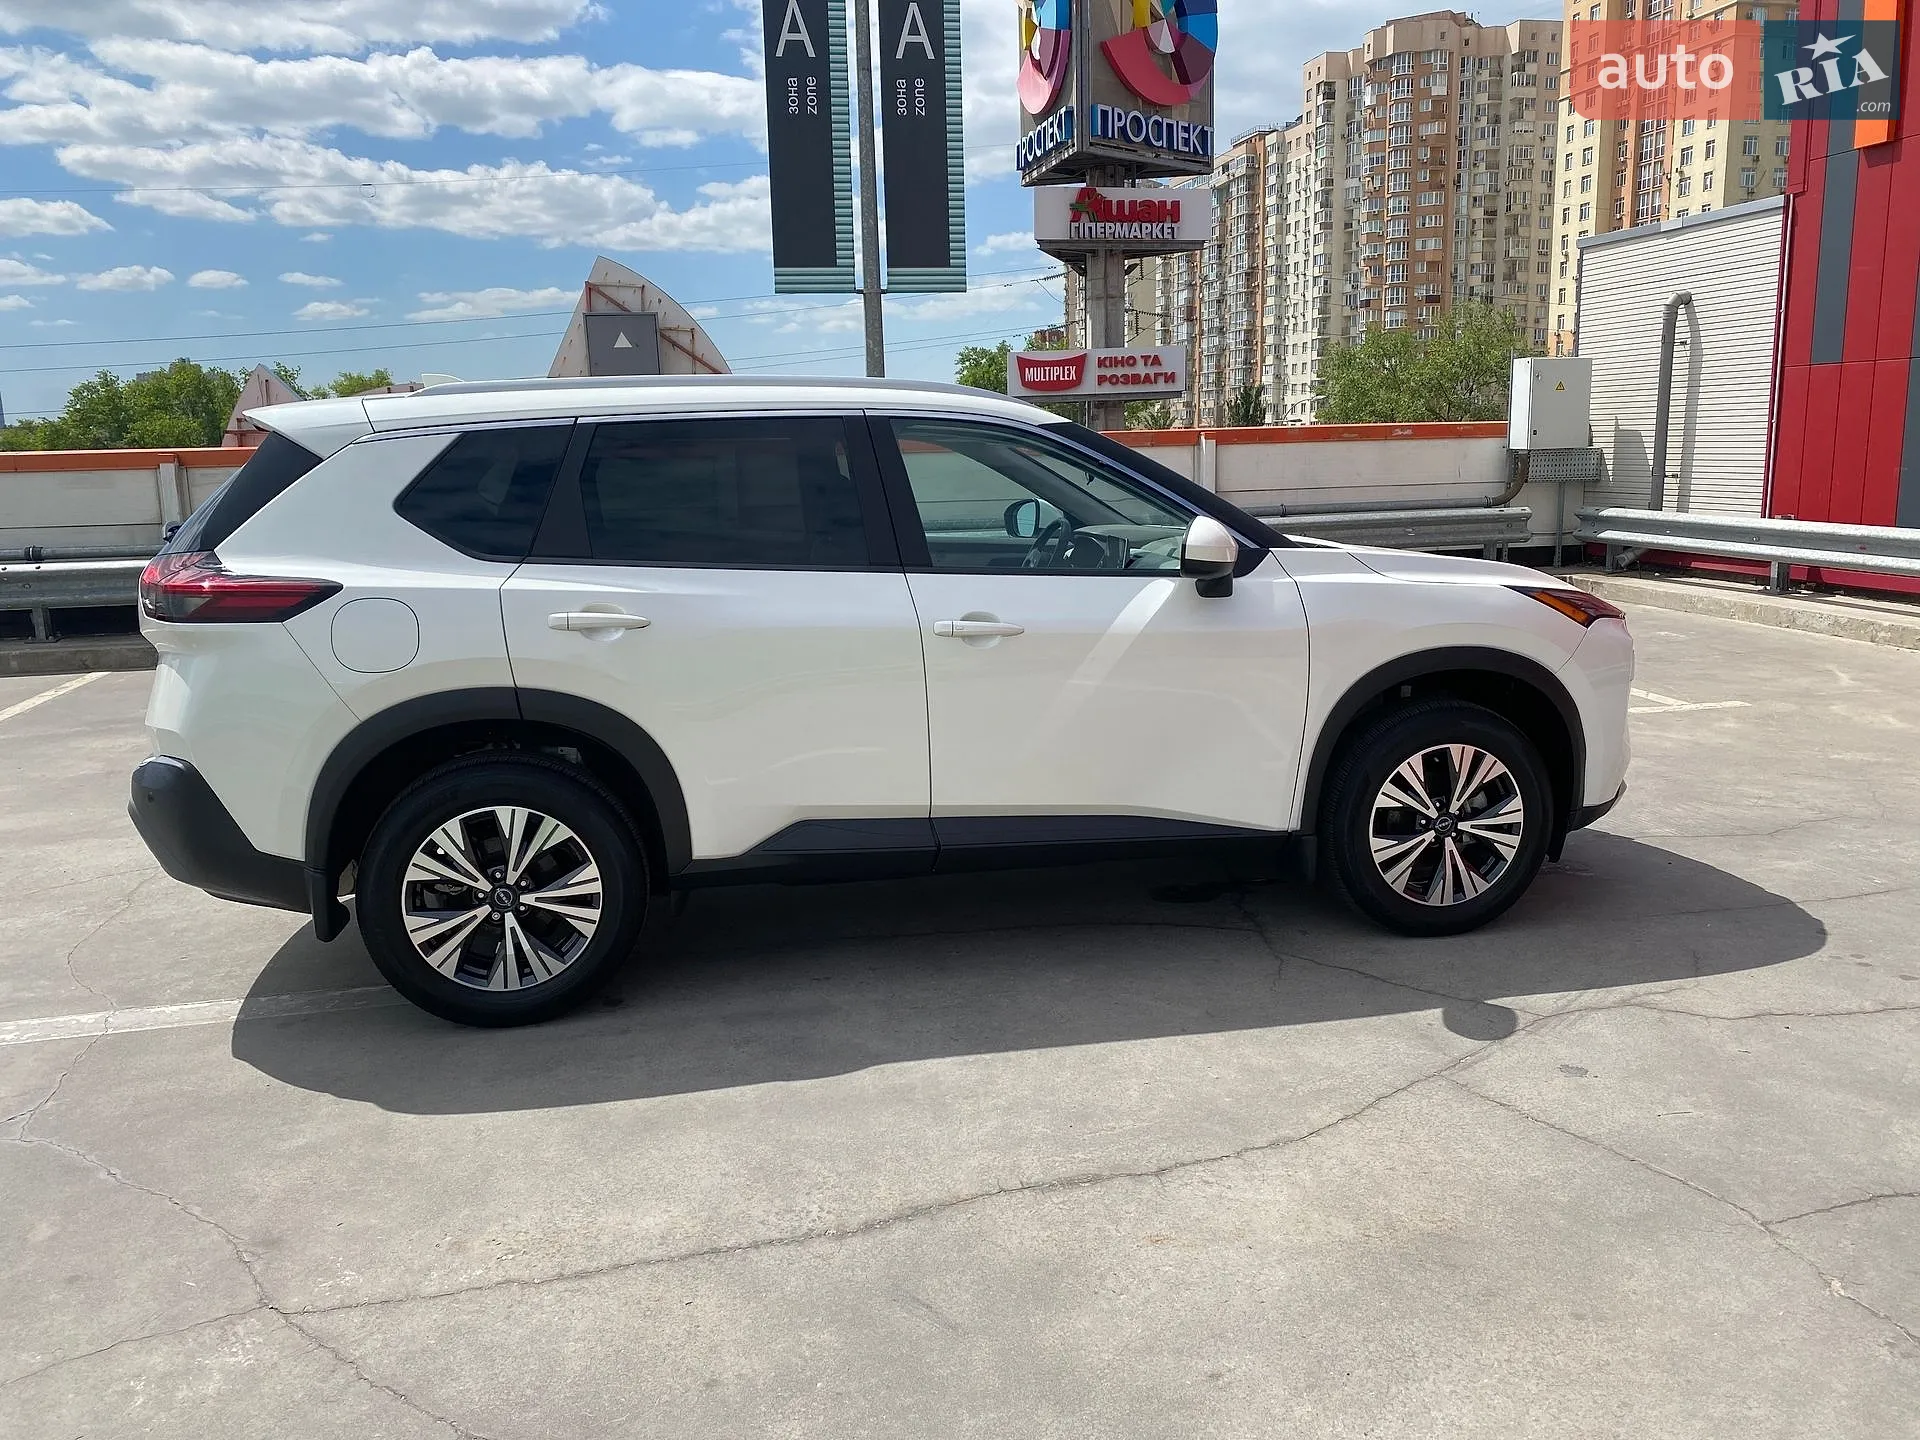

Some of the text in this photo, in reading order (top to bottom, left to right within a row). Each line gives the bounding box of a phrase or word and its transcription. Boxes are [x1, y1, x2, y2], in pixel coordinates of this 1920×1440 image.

[787, 76, 799, 115] зона
[806, 76, 818, 115] zone
[896, 78, 907, 116] зона
[914, 77, 925, 117] zone
[1015, 106, 1071, 172] ПРОСПЕКТ
[1097, 103, 1214, 158] ПРОСПЕКТ
[1069, 187, 1181, 223] Ашан
[1069, 222, 1180, 240] ГІПЕРМАРКЕТ
[1025, 366, 1077, 382] MULTIPLEX
[1097, 354, 1162, 369] КІНО ТА
[1097, 371, 1176, 386] РОЗВАГИ
